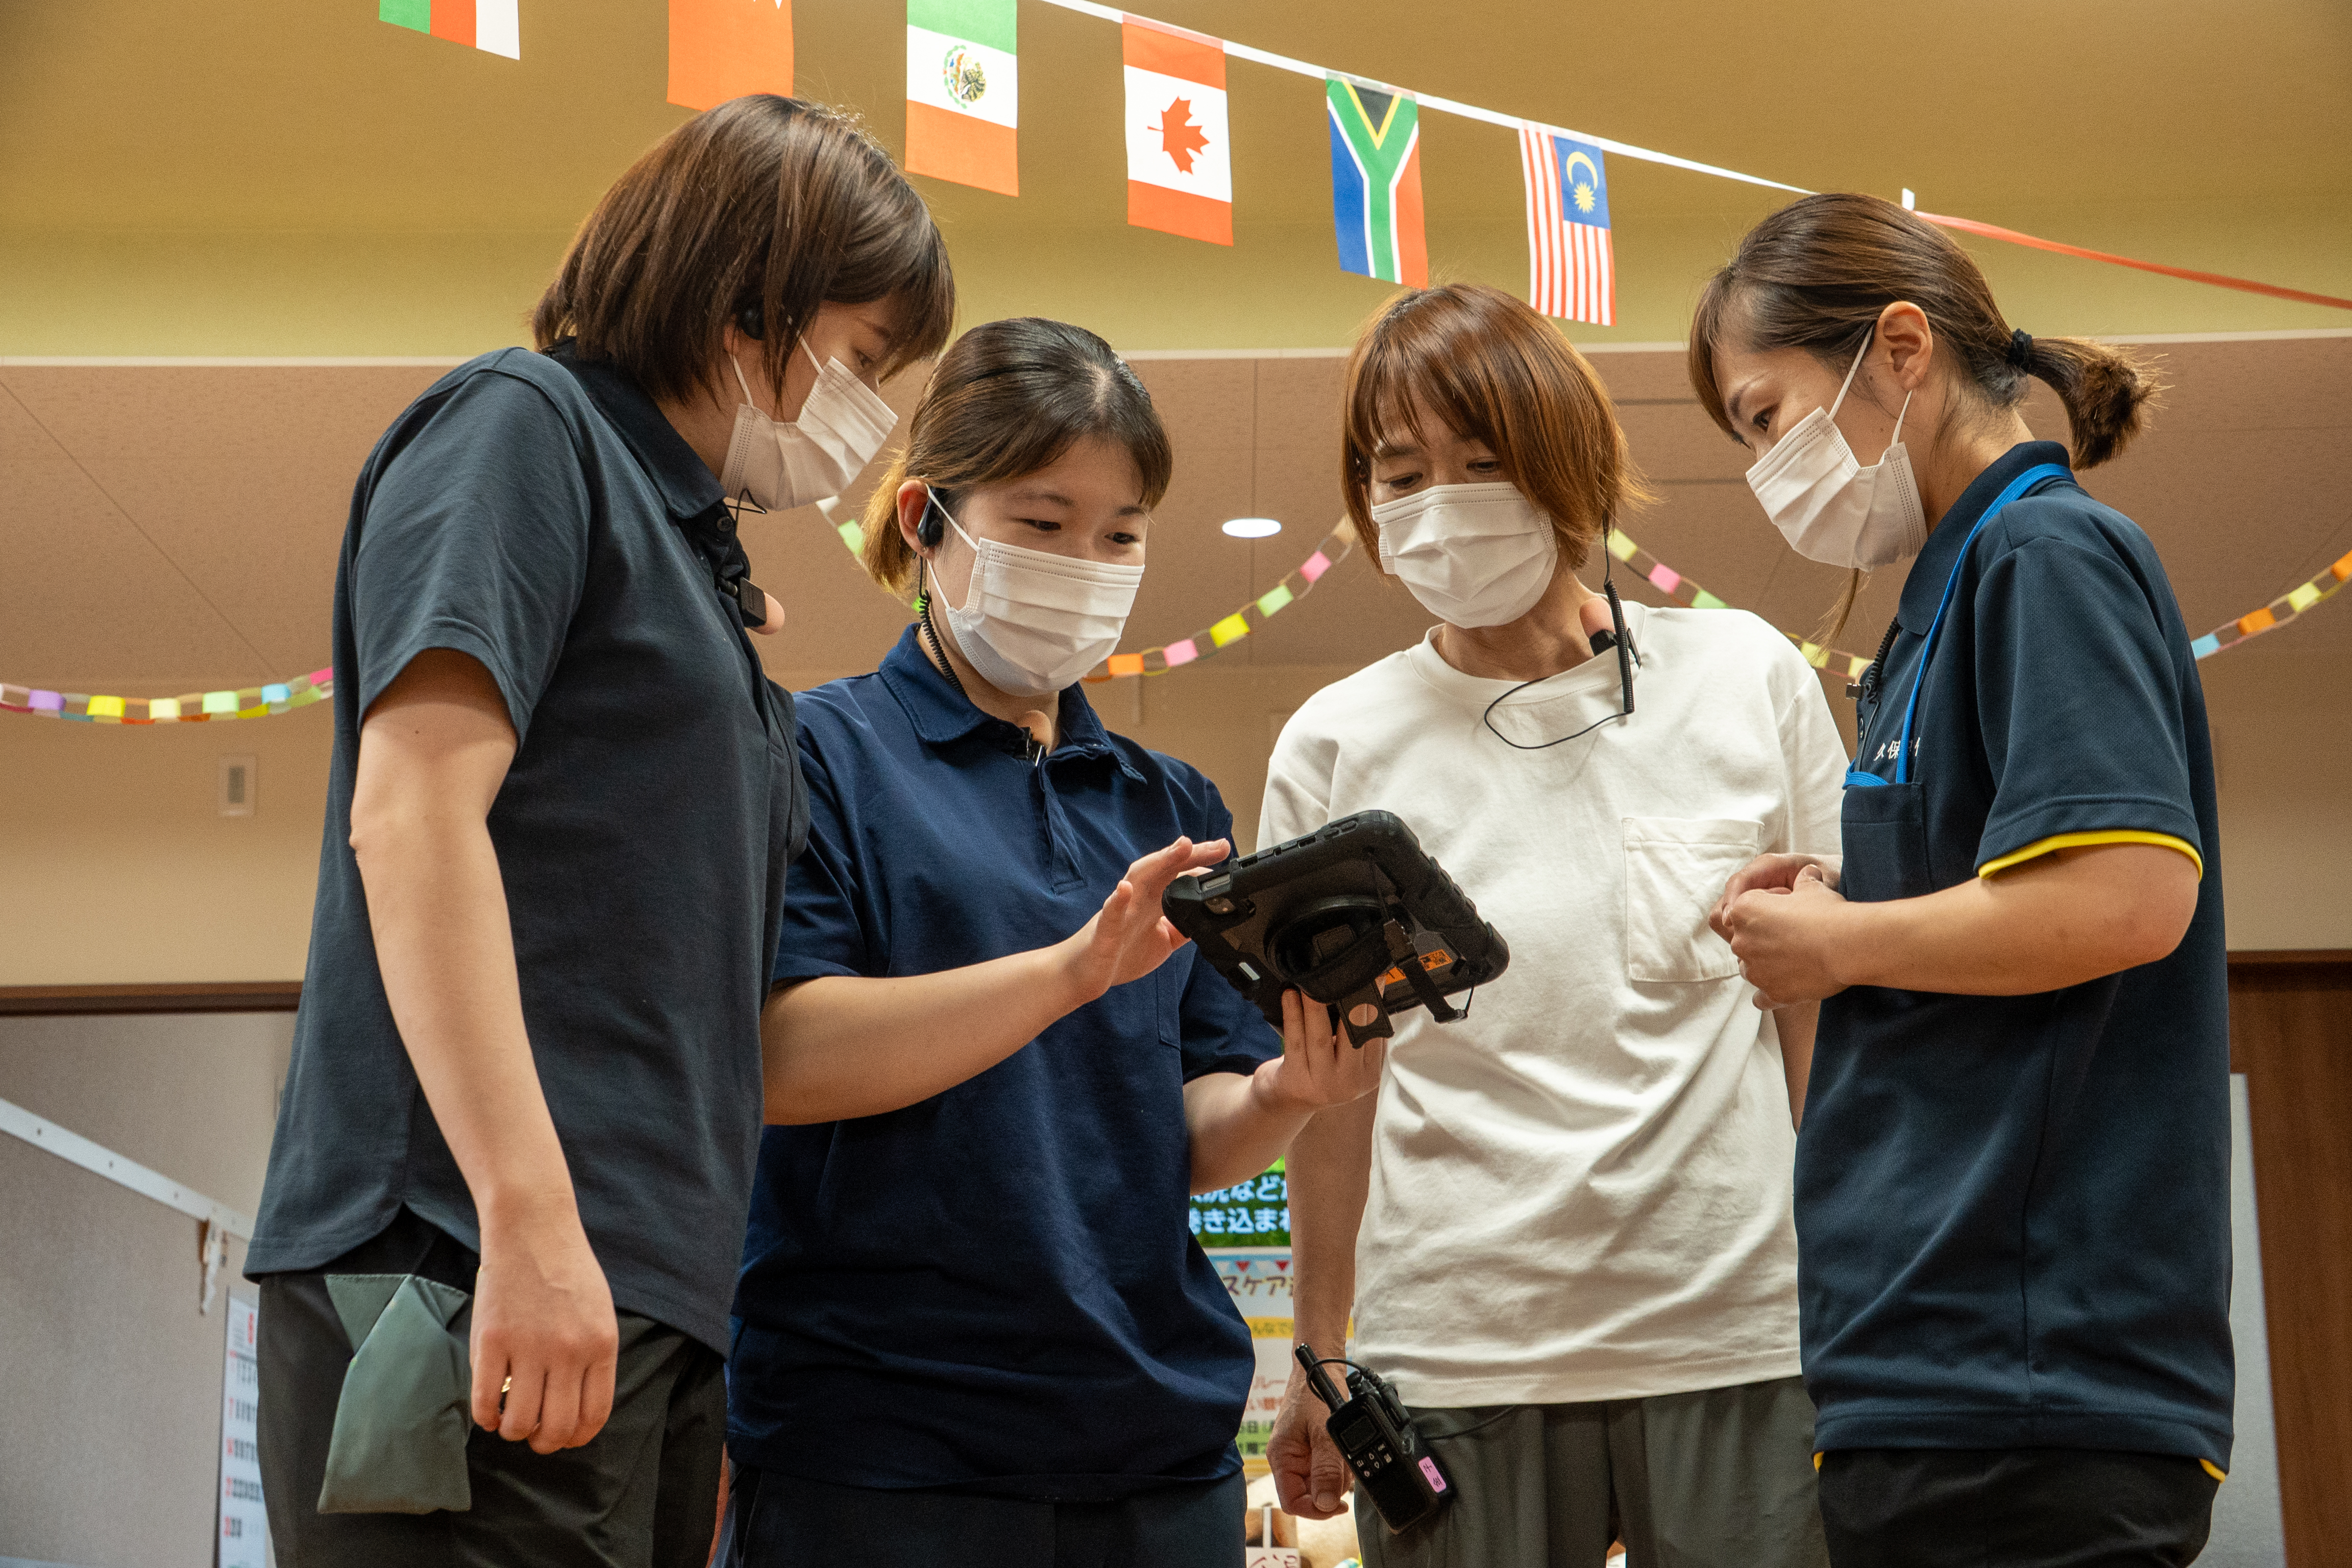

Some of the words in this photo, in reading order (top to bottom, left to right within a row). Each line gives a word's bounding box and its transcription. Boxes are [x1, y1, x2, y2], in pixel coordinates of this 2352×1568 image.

[1874, 737, 1920, 761] 久保
[1223, 1276, 1294, 1297] スケア
